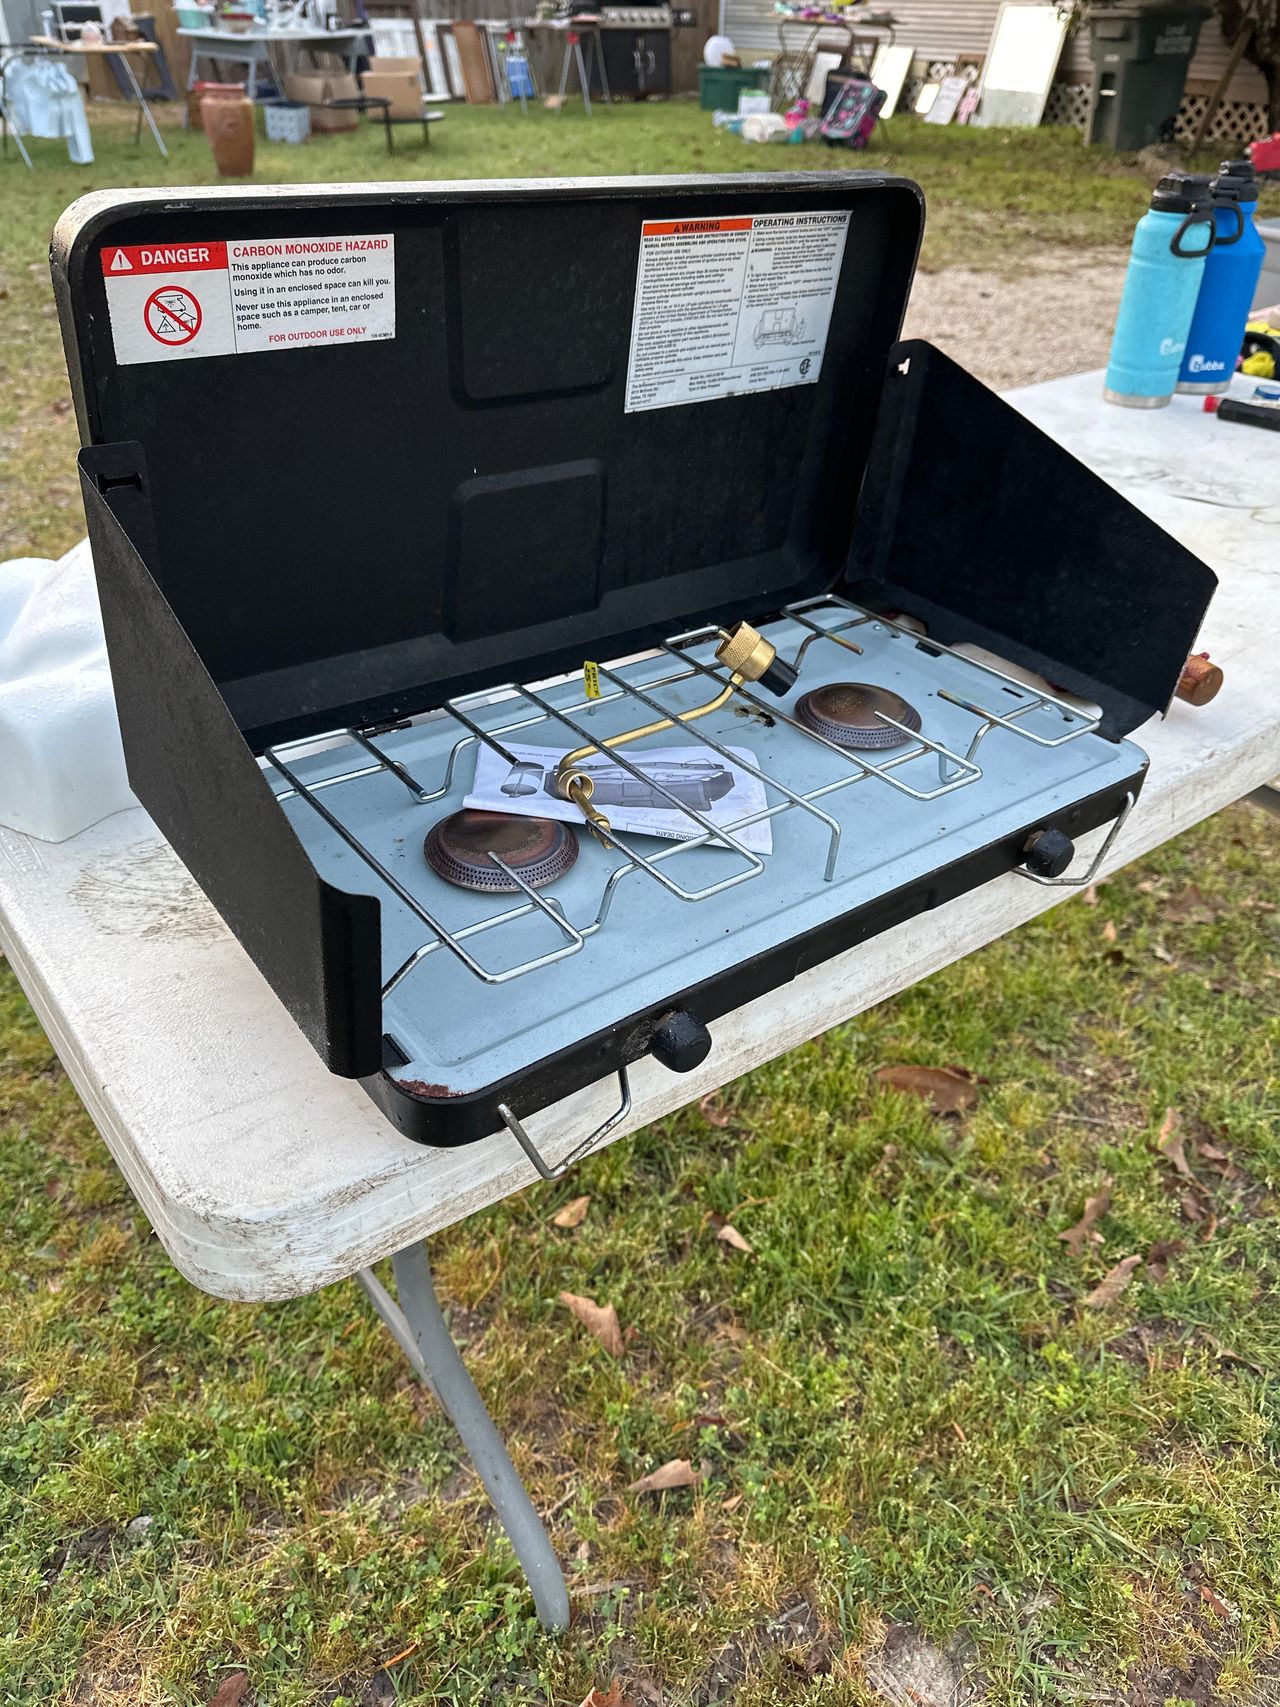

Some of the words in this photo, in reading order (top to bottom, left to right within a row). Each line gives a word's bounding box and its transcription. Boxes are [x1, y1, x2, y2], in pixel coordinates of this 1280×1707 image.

[681, 222, 720, 231] WARNING
[753, 217, 794, 227] OPERATING
[795, 215, 847, 224] INSTRUCTIONS
[232, 245, 281, 257] CARBON
[285, 242, 342, 254] MONOXIDE
[345, 239, 388, 251] HAZARD
[140, 247, 209, 265] DANGER
[251, 260, 289, 271] appliance
[307, 258, 338, 268] produce
[232, 271, 272, 280] monoxide
[233, 287, 257, 297] Using
[287, 283, 321, 291] enclosed
[293, 297, 329, 307] appliance
[351, 293, 383, 301] enclosed
[236, 313, 260, 322] space
[300, 308, 330, 316] camper,
[331, 305, 347, 313] tent,
[236, 322, 261, 330] home.
[269, 334, 285, 342] FOR
[287, 330, 327, 340] OUTDOOR
[329, 328, 344, 336] USE
[347, 326, 366, 335] ONLY
[655, 830, 675, 839] DEATH
